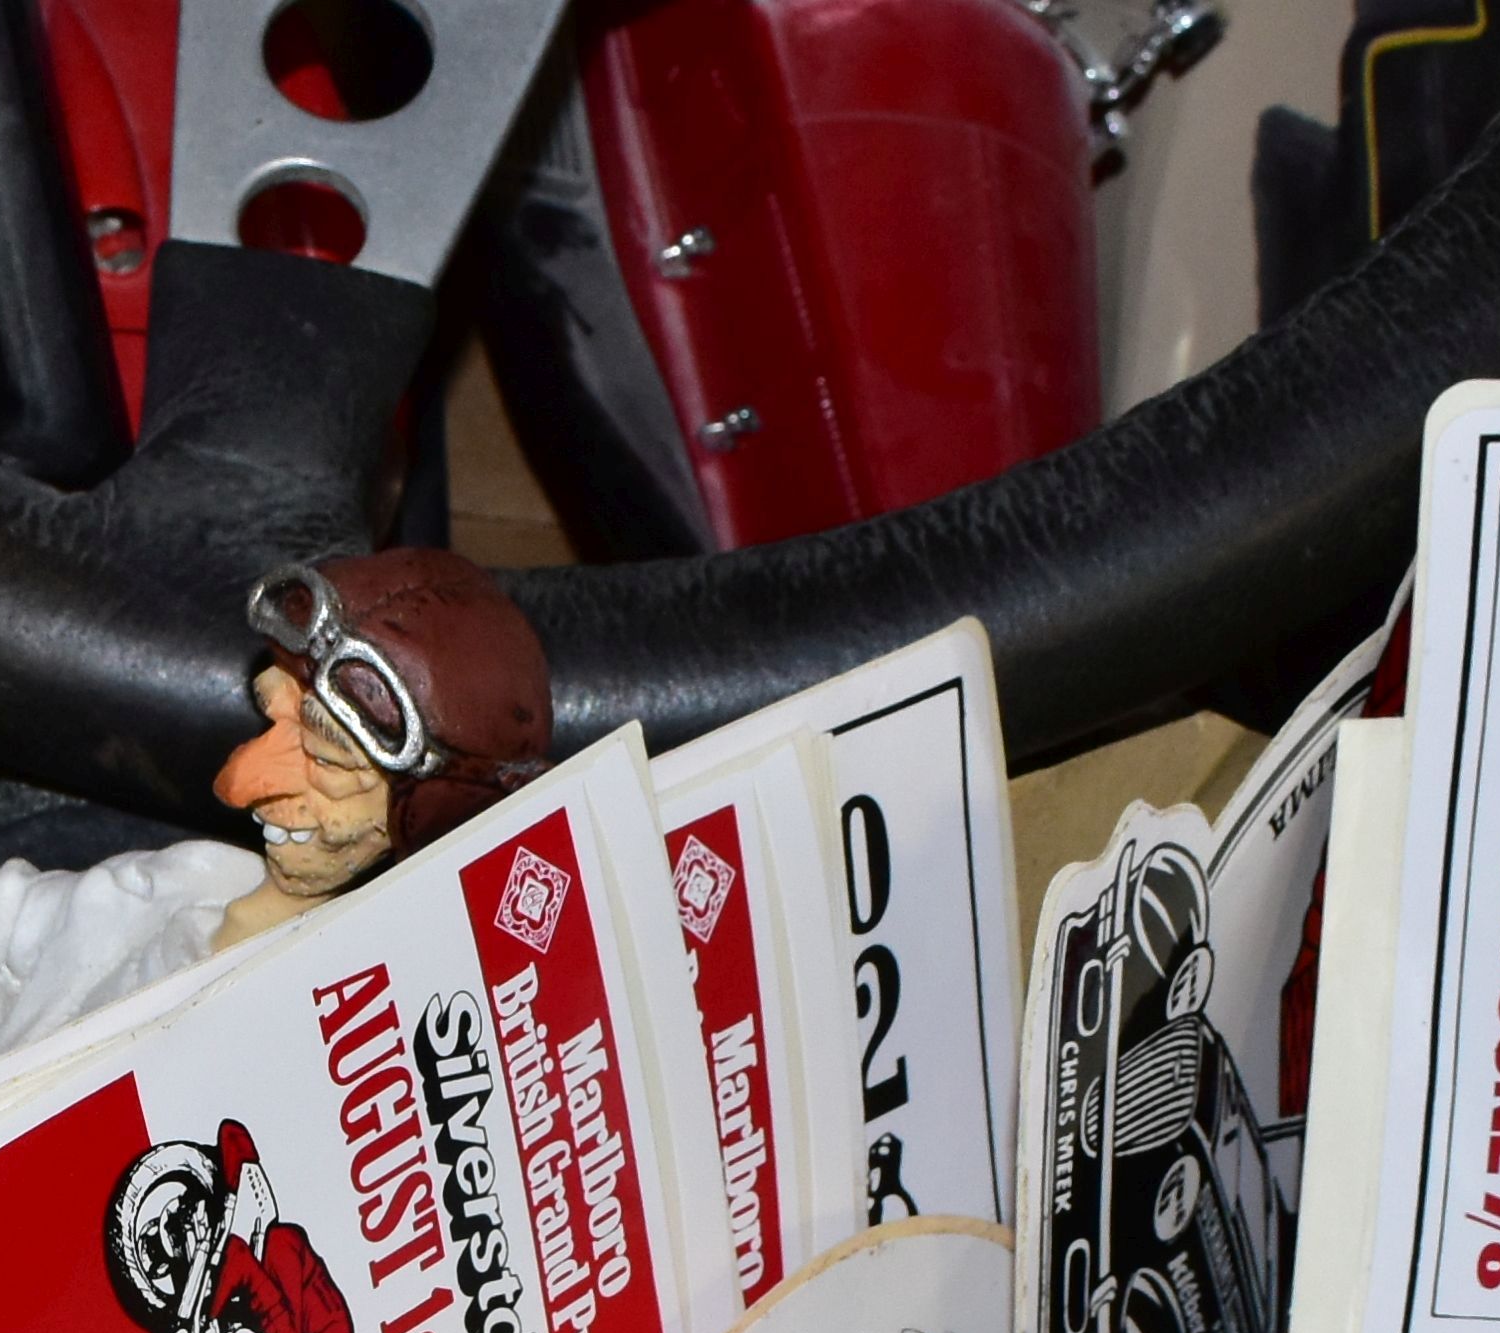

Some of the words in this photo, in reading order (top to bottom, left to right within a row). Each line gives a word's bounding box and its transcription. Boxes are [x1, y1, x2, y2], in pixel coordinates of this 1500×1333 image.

[312, 961, 447, 1289] AUGUST
[491, 961, 562, 1136] British
[1058, 1041, 1080, 1128] CHRIS
[519, 1138, 593, 1306] Grand
[555, 1018, 631, 1299] Marlboro
[709, 1013, 768, 1292] Marlboro
[1054, 1136, 1076, 1214] MEEK
